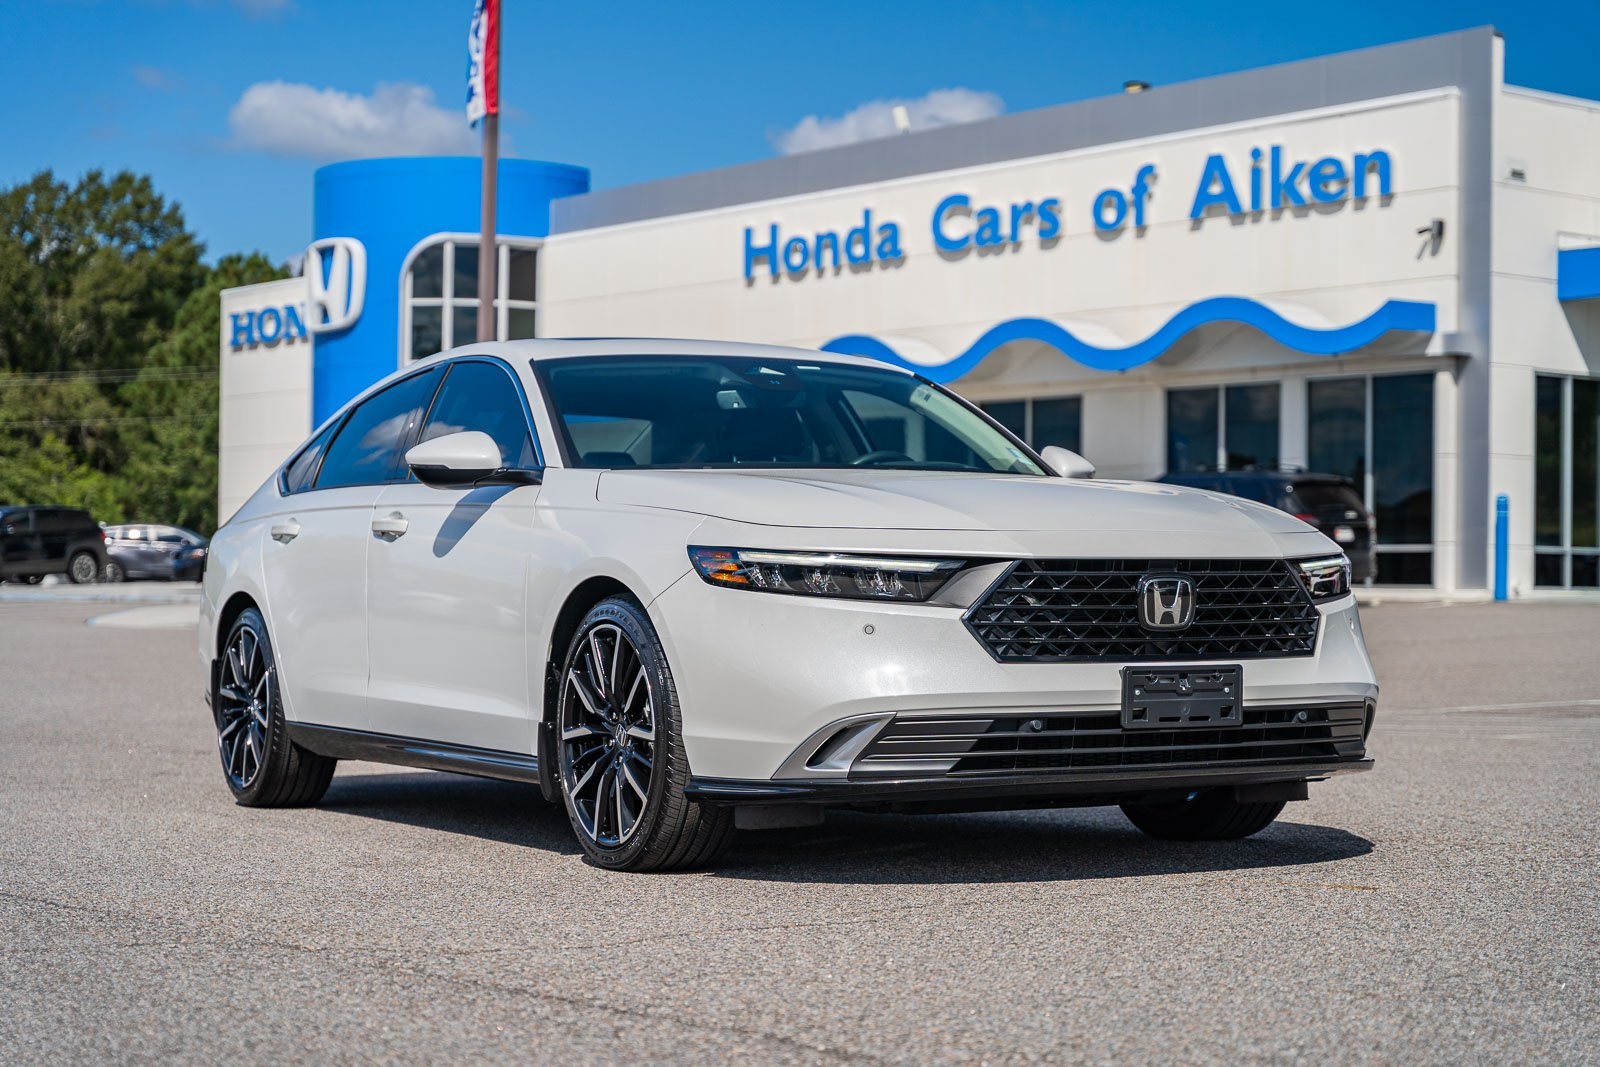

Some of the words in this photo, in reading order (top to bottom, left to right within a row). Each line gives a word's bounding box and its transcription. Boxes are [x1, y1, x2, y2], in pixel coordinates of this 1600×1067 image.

[744, 208, 904, 280] Honda
[931, 193, 1062, 253] Cars
[1092, 164, 1157, 232] of
[1189, 145, 1393, 221] Aiken
[229, 304, 308, 347] HON
